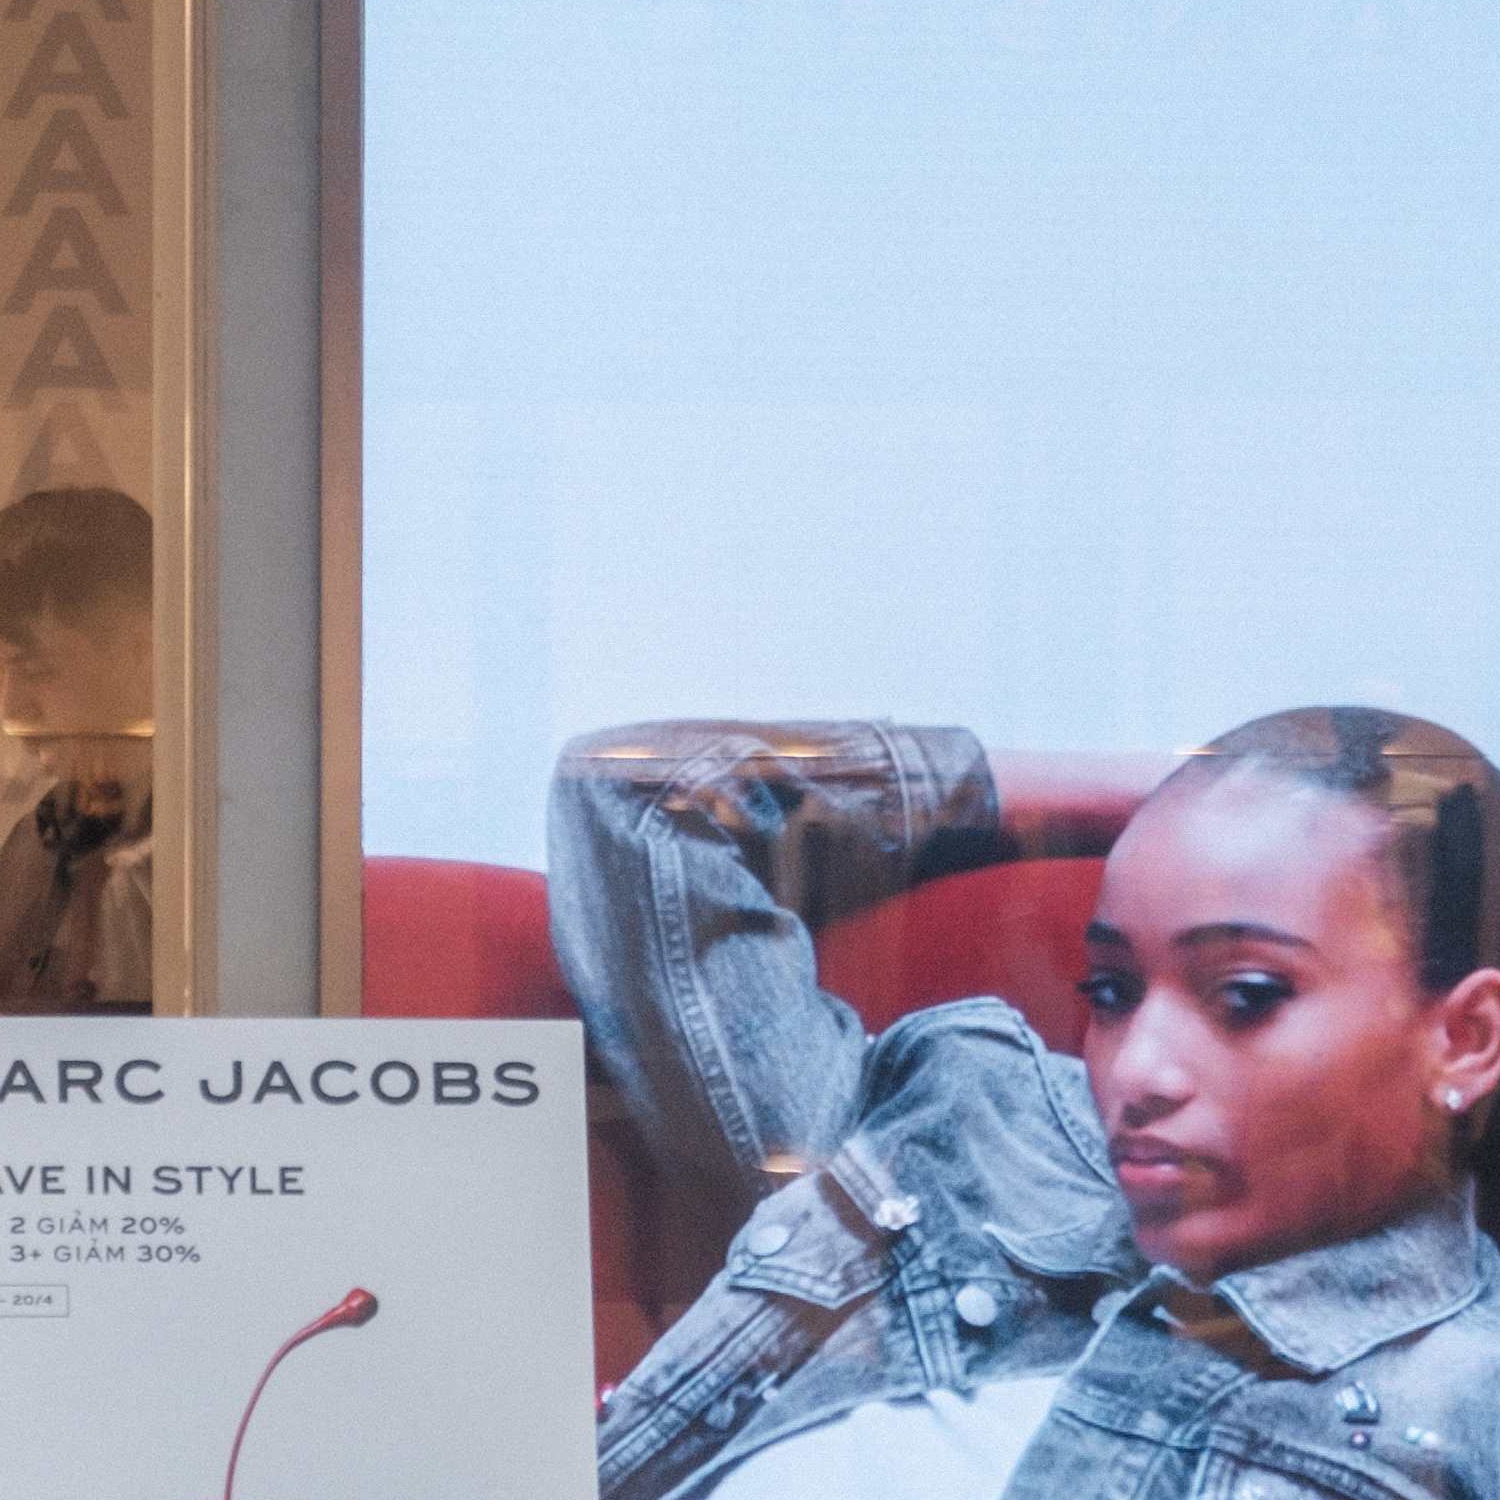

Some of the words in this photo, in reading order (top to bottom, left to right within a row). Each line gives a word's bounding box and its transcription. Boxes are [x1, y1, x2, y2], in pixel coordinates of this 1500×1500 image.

[199, 1059, 541, 1107] JACOBS
[85, 1165, 132, 1196] IN
[151, 1164, 305, 1197] STYLE
[9, 1216, 26, 1235] 2
[36, 1209, 109, 1235] GIẢM
[120, 1215, 186, 1235] 20%
[9, 1244, 42, 1263] 3+
[53, 1238, 126, 1263] GIẢM
[136, 1244, 201, 1263] 30%
[12, 1294, 53, 1306] 20/4
